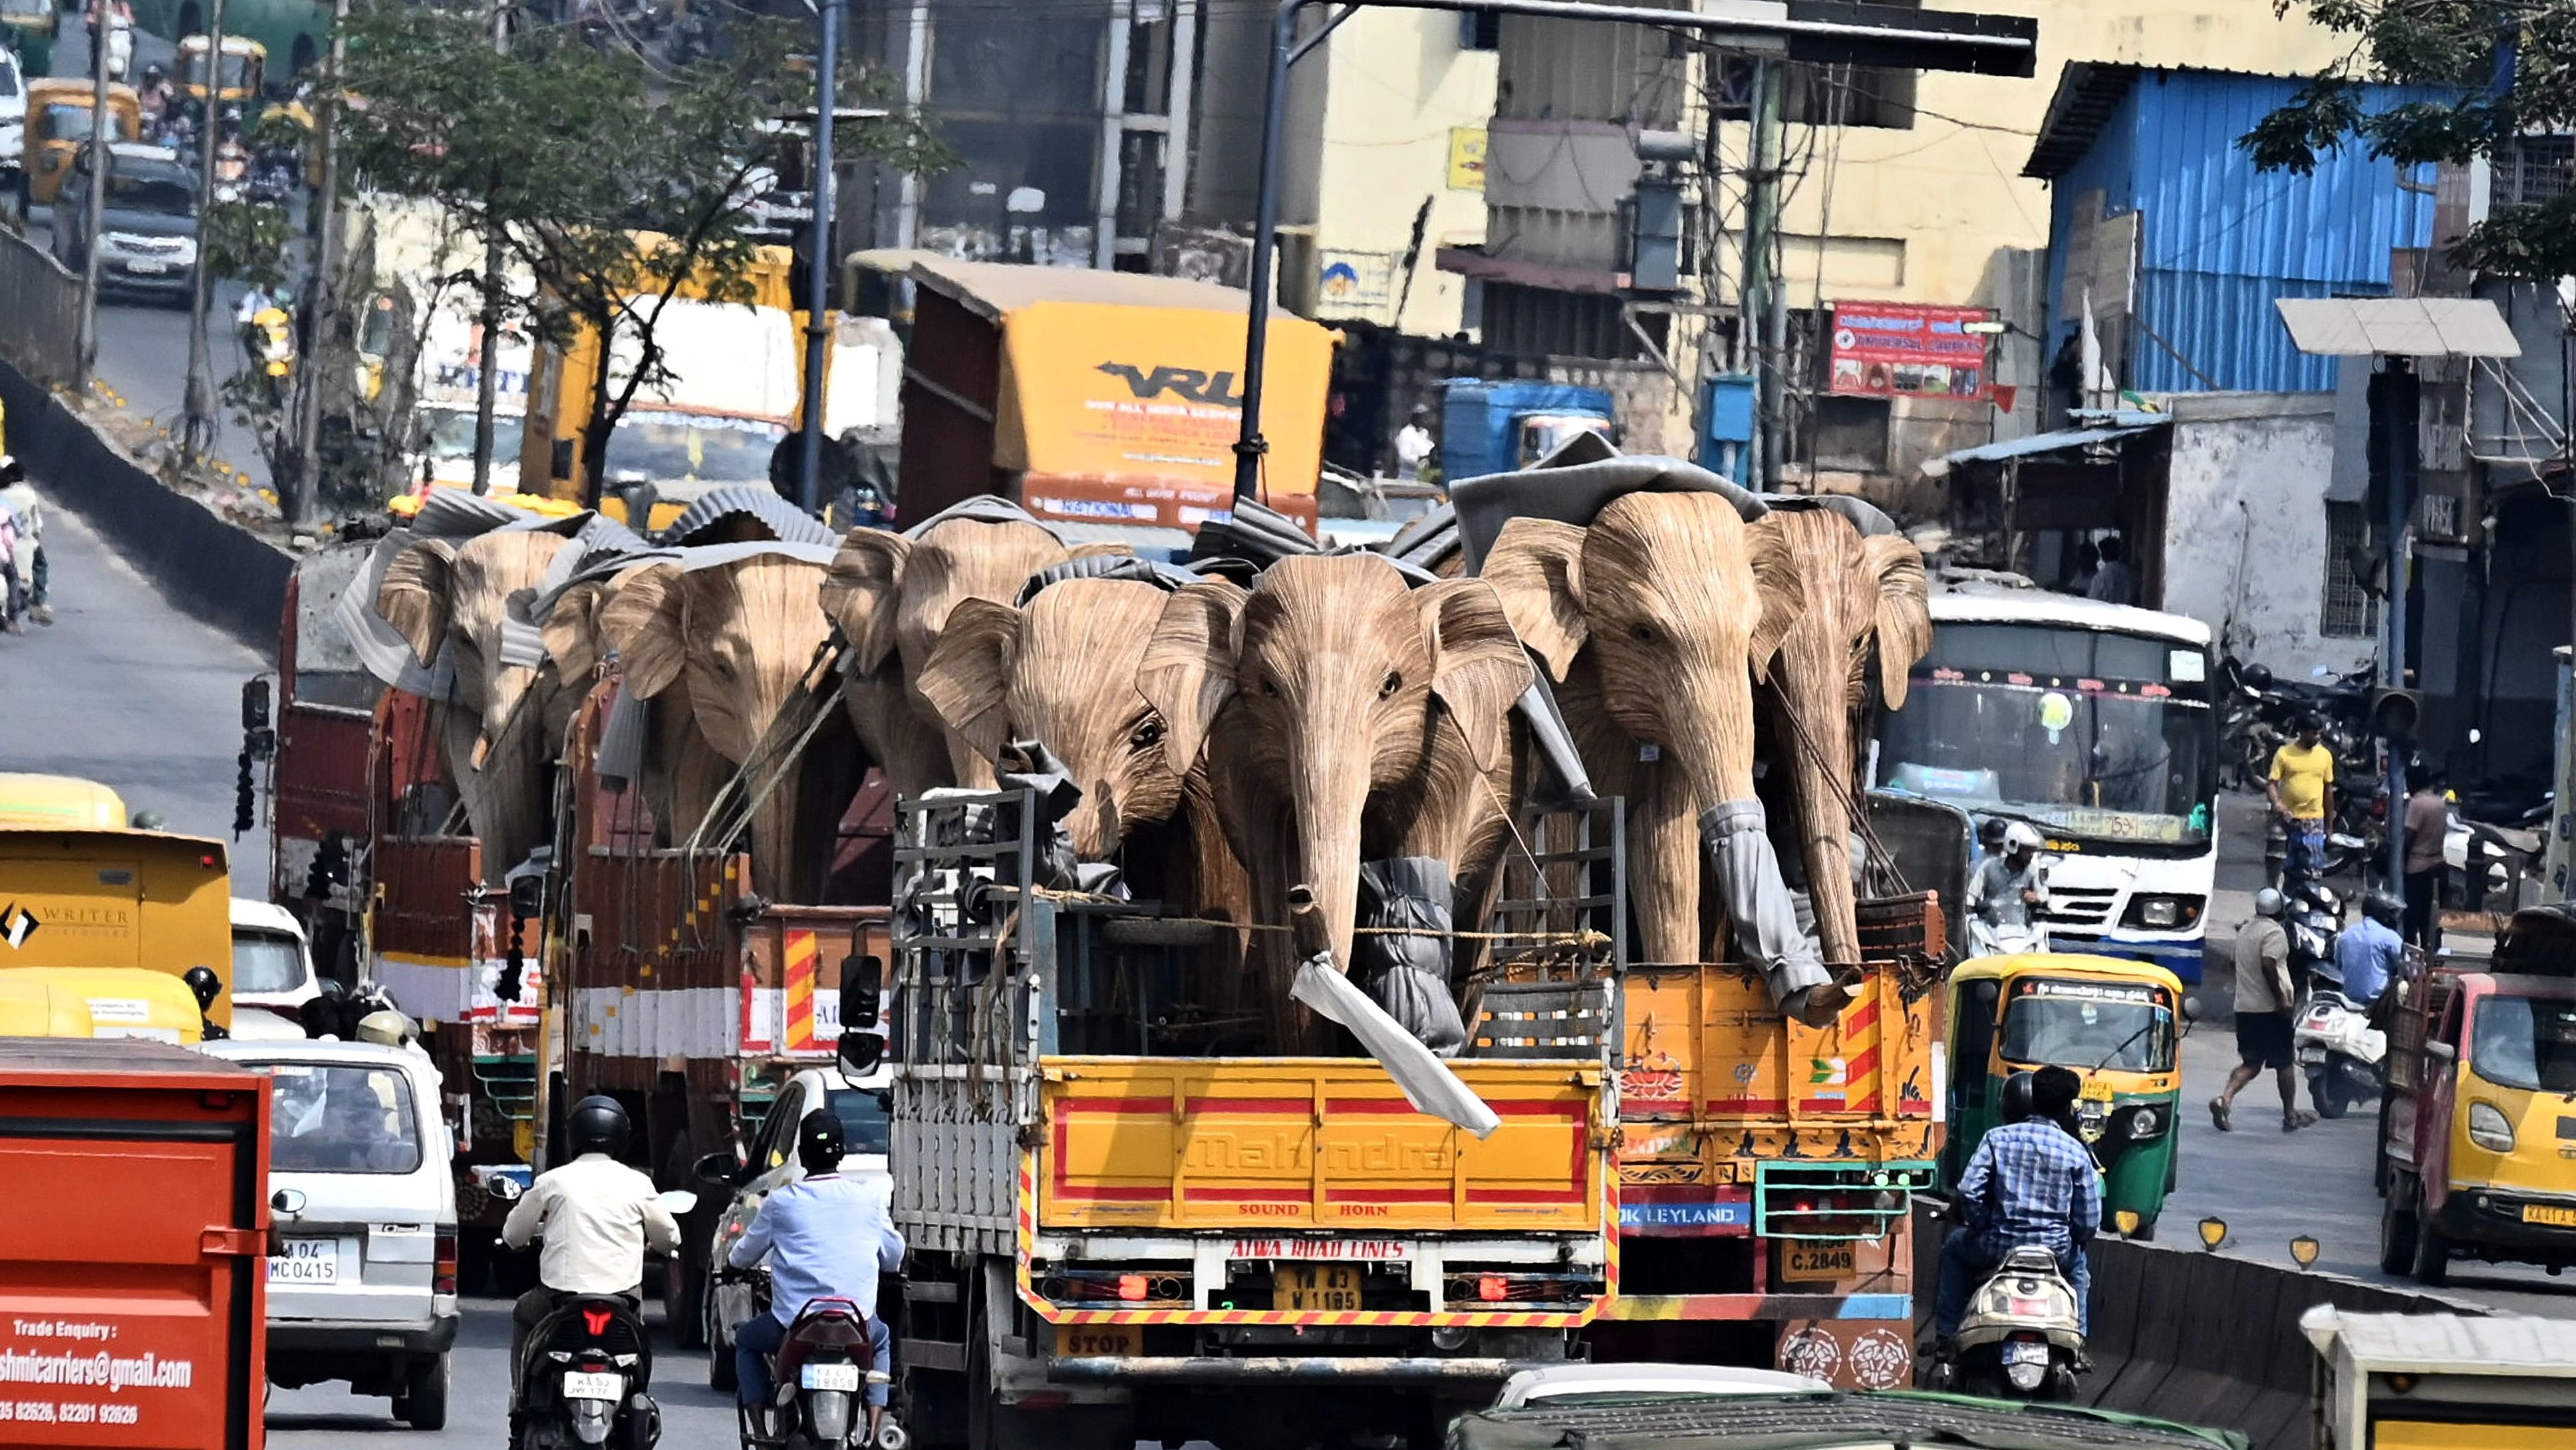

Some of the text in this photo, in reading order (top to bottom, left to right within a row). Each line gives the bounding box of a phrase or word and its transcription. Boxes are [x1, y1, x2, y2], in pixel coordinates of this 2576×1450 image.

[1094, 361, 1242, 407] VRL
[43, 906, 128, 923] WRITER
[1239, 1205, 1388, 1217] SOUND HORN
[1647, 1209, 1735, 1223] LEYLAND
[299, 1242, 319, 1258] 04
[1230, 1240, 1282, 1256] AIWA
[1351, 1241, 1403, 1258] LINES
[1792, 1252, 1852, 1271] C.2849
[1295, 1266, 1317, 1289] TN
[13, 1320, 54, 1337] Trade
[56, 1321, 110, 1340] Enquiry
[1068, 1335, 1129, 1354] STOP
[59, 1403, 96, 1423] 82201
